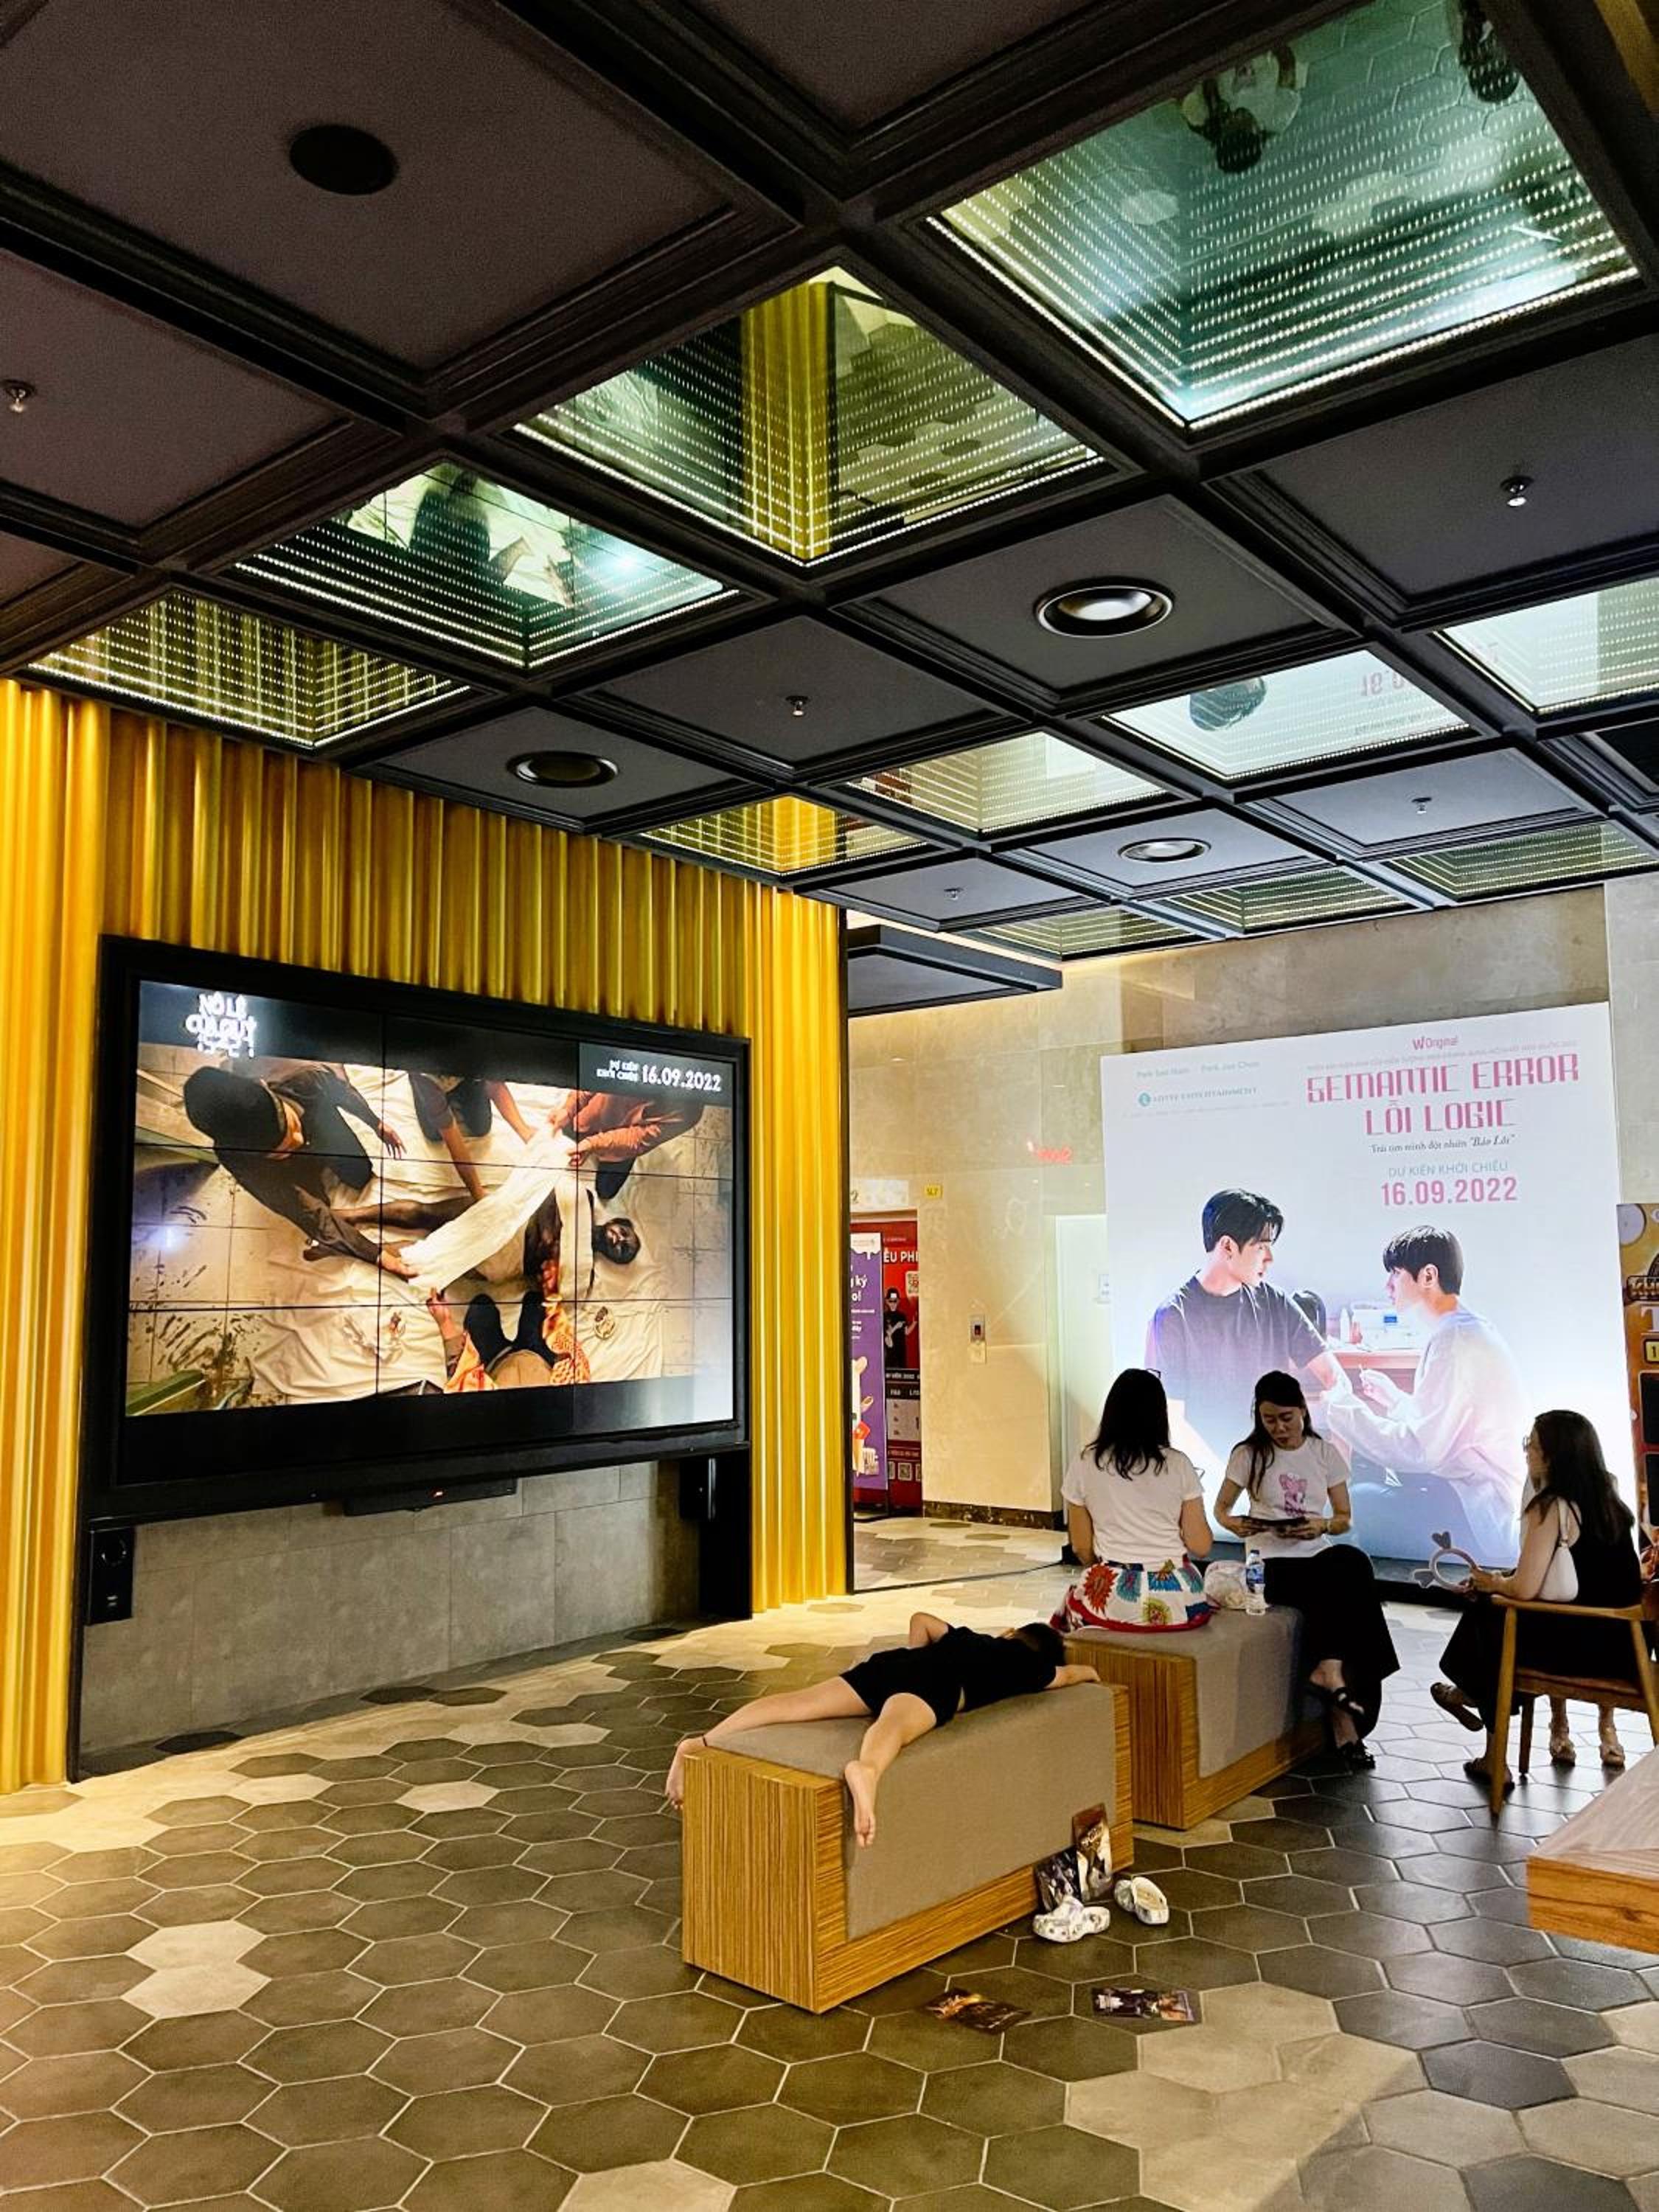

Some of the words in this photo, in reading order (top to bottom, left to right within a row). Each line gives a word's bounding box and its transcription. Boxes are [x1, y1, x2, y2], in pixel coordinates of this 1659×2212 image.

[641, 1064, 722, 1092] 16.09.2022
[1307, 1062, 1461, 1104] SEMANTIC
[1472, 1053, 1579, 1090] ERROR
[1424, 1098, 1517, 1133] LOGIC
[1380, 1177, 1518, 1206] 16.09.2022
